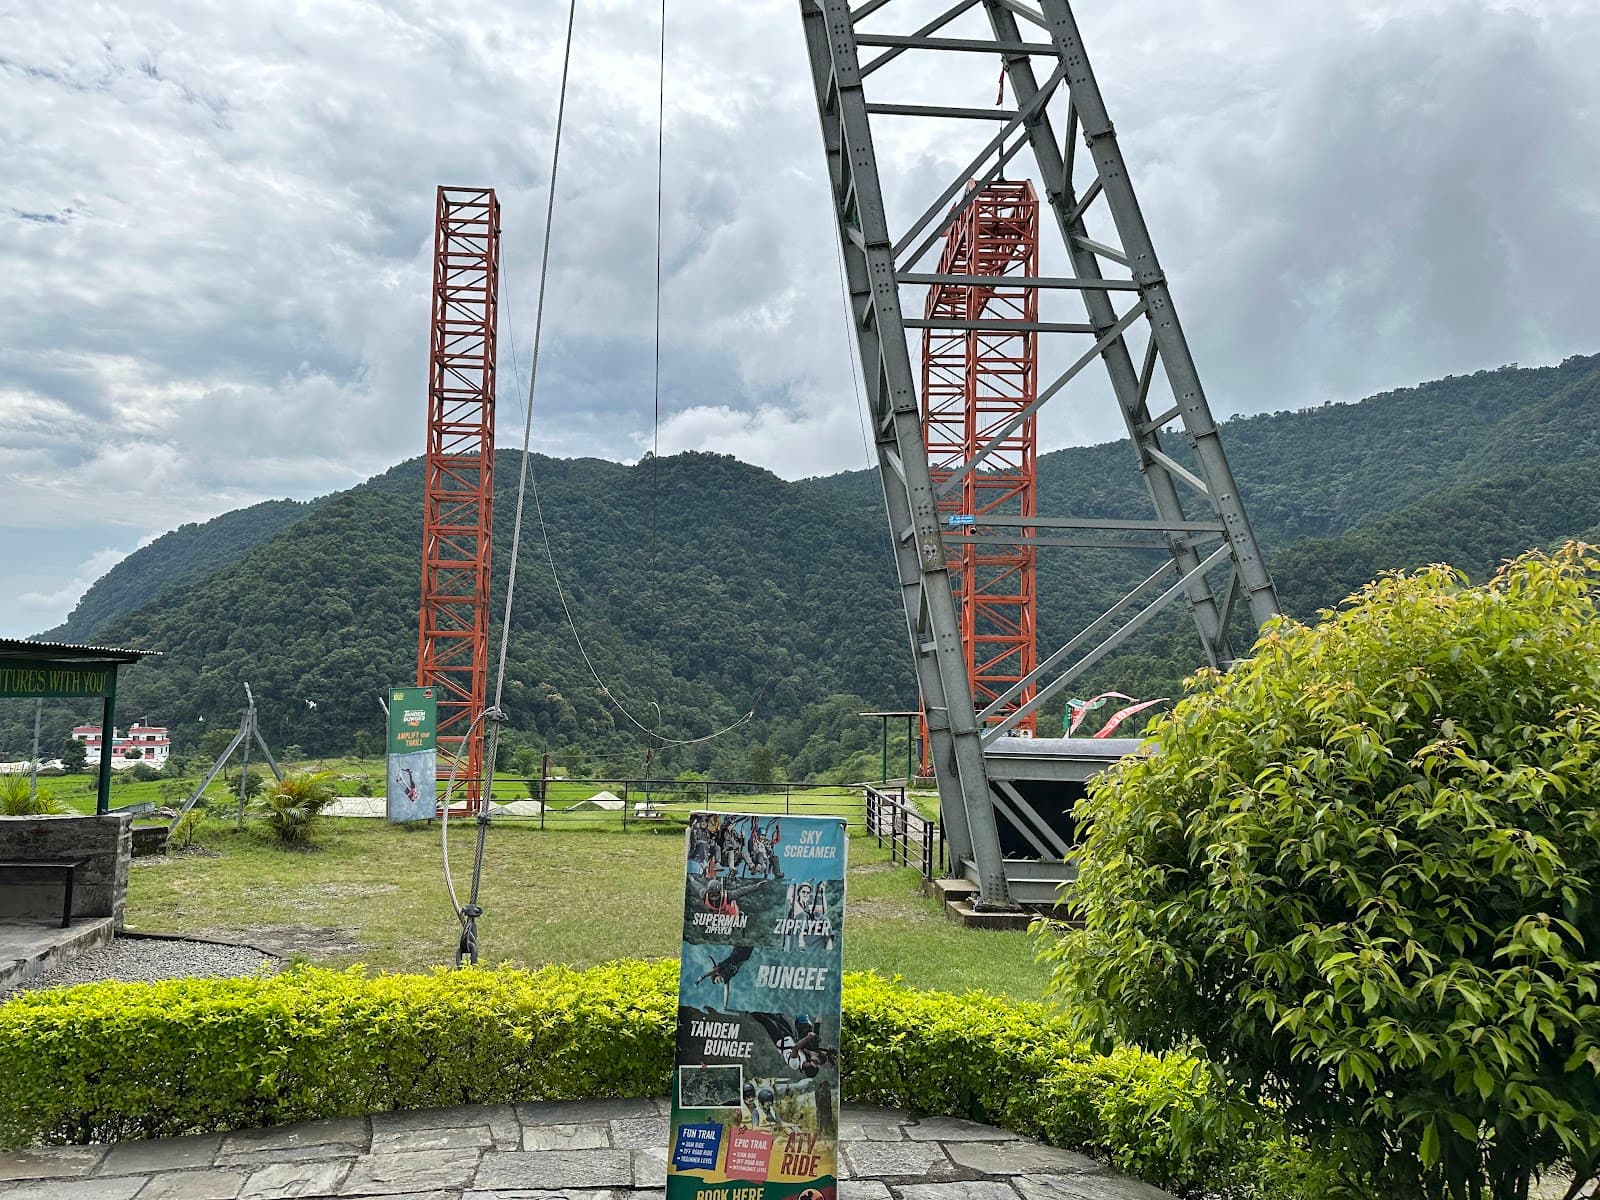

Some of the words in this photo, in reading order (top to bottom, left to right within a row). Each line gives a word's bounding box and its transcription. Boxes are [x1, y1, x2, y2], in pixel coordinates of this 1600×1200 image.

[49, 671, 80, 693] WITH
[799, 830, 823, 844] SKY
[783, 844, 836, 859] SCREAMER
[692, 912, 748, 930] SUPERMAN
[773, 918, 831, 936] ZIPFLYER
[704, 925, 732, 936] ZIPFLYER
[756, 965, 829, 991] BUNGEE
[690, 1020, 740, 1040] TANDEM
[703, 1039, 754, 1058] BUNGEE
[682, 1128, 697, 1138] FUN
[698, 1129, 716, 1140] TRAIL
[784, 1131, 818, 1154] ATV
[734, 1138, 750, 1148] EPIC
[750, 1140, 768, 1150] TRAIL
[780, 1153, 821, 1177] RIDE
[696, 1189, 729, 1200] BOOK
[732, 1187, 764, 1200] HERE
